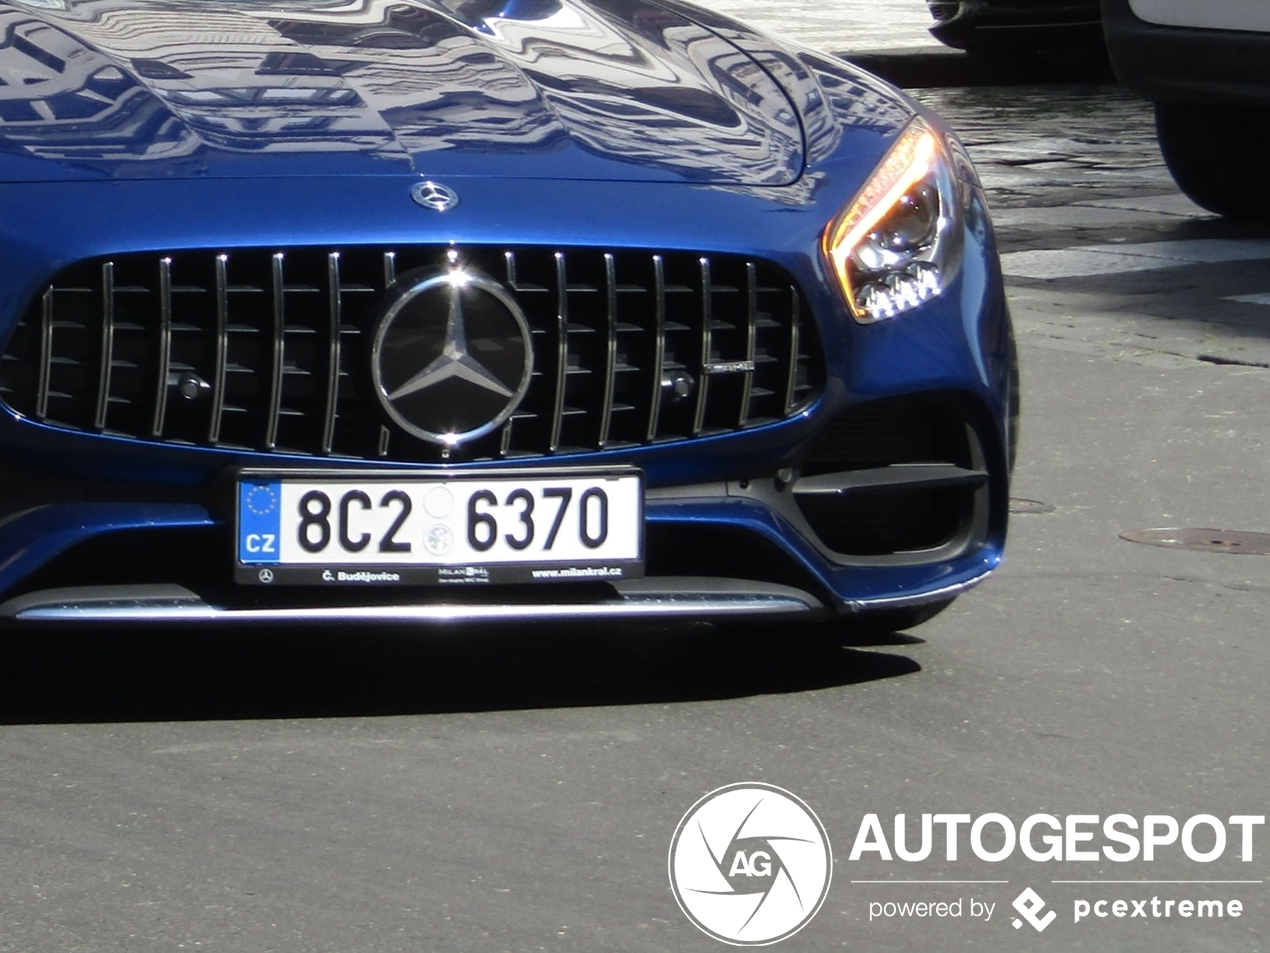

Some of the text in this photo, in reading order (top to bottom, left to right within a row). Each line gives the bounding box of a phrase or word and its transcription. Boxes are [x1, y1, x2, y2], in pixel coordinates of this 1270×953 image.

[246, 486, 608, 554] CZ 8C2 6370
[322, 569, 400, 582] Č. Budějovice
[532, 566, 622, 579] www.milankral.cz
